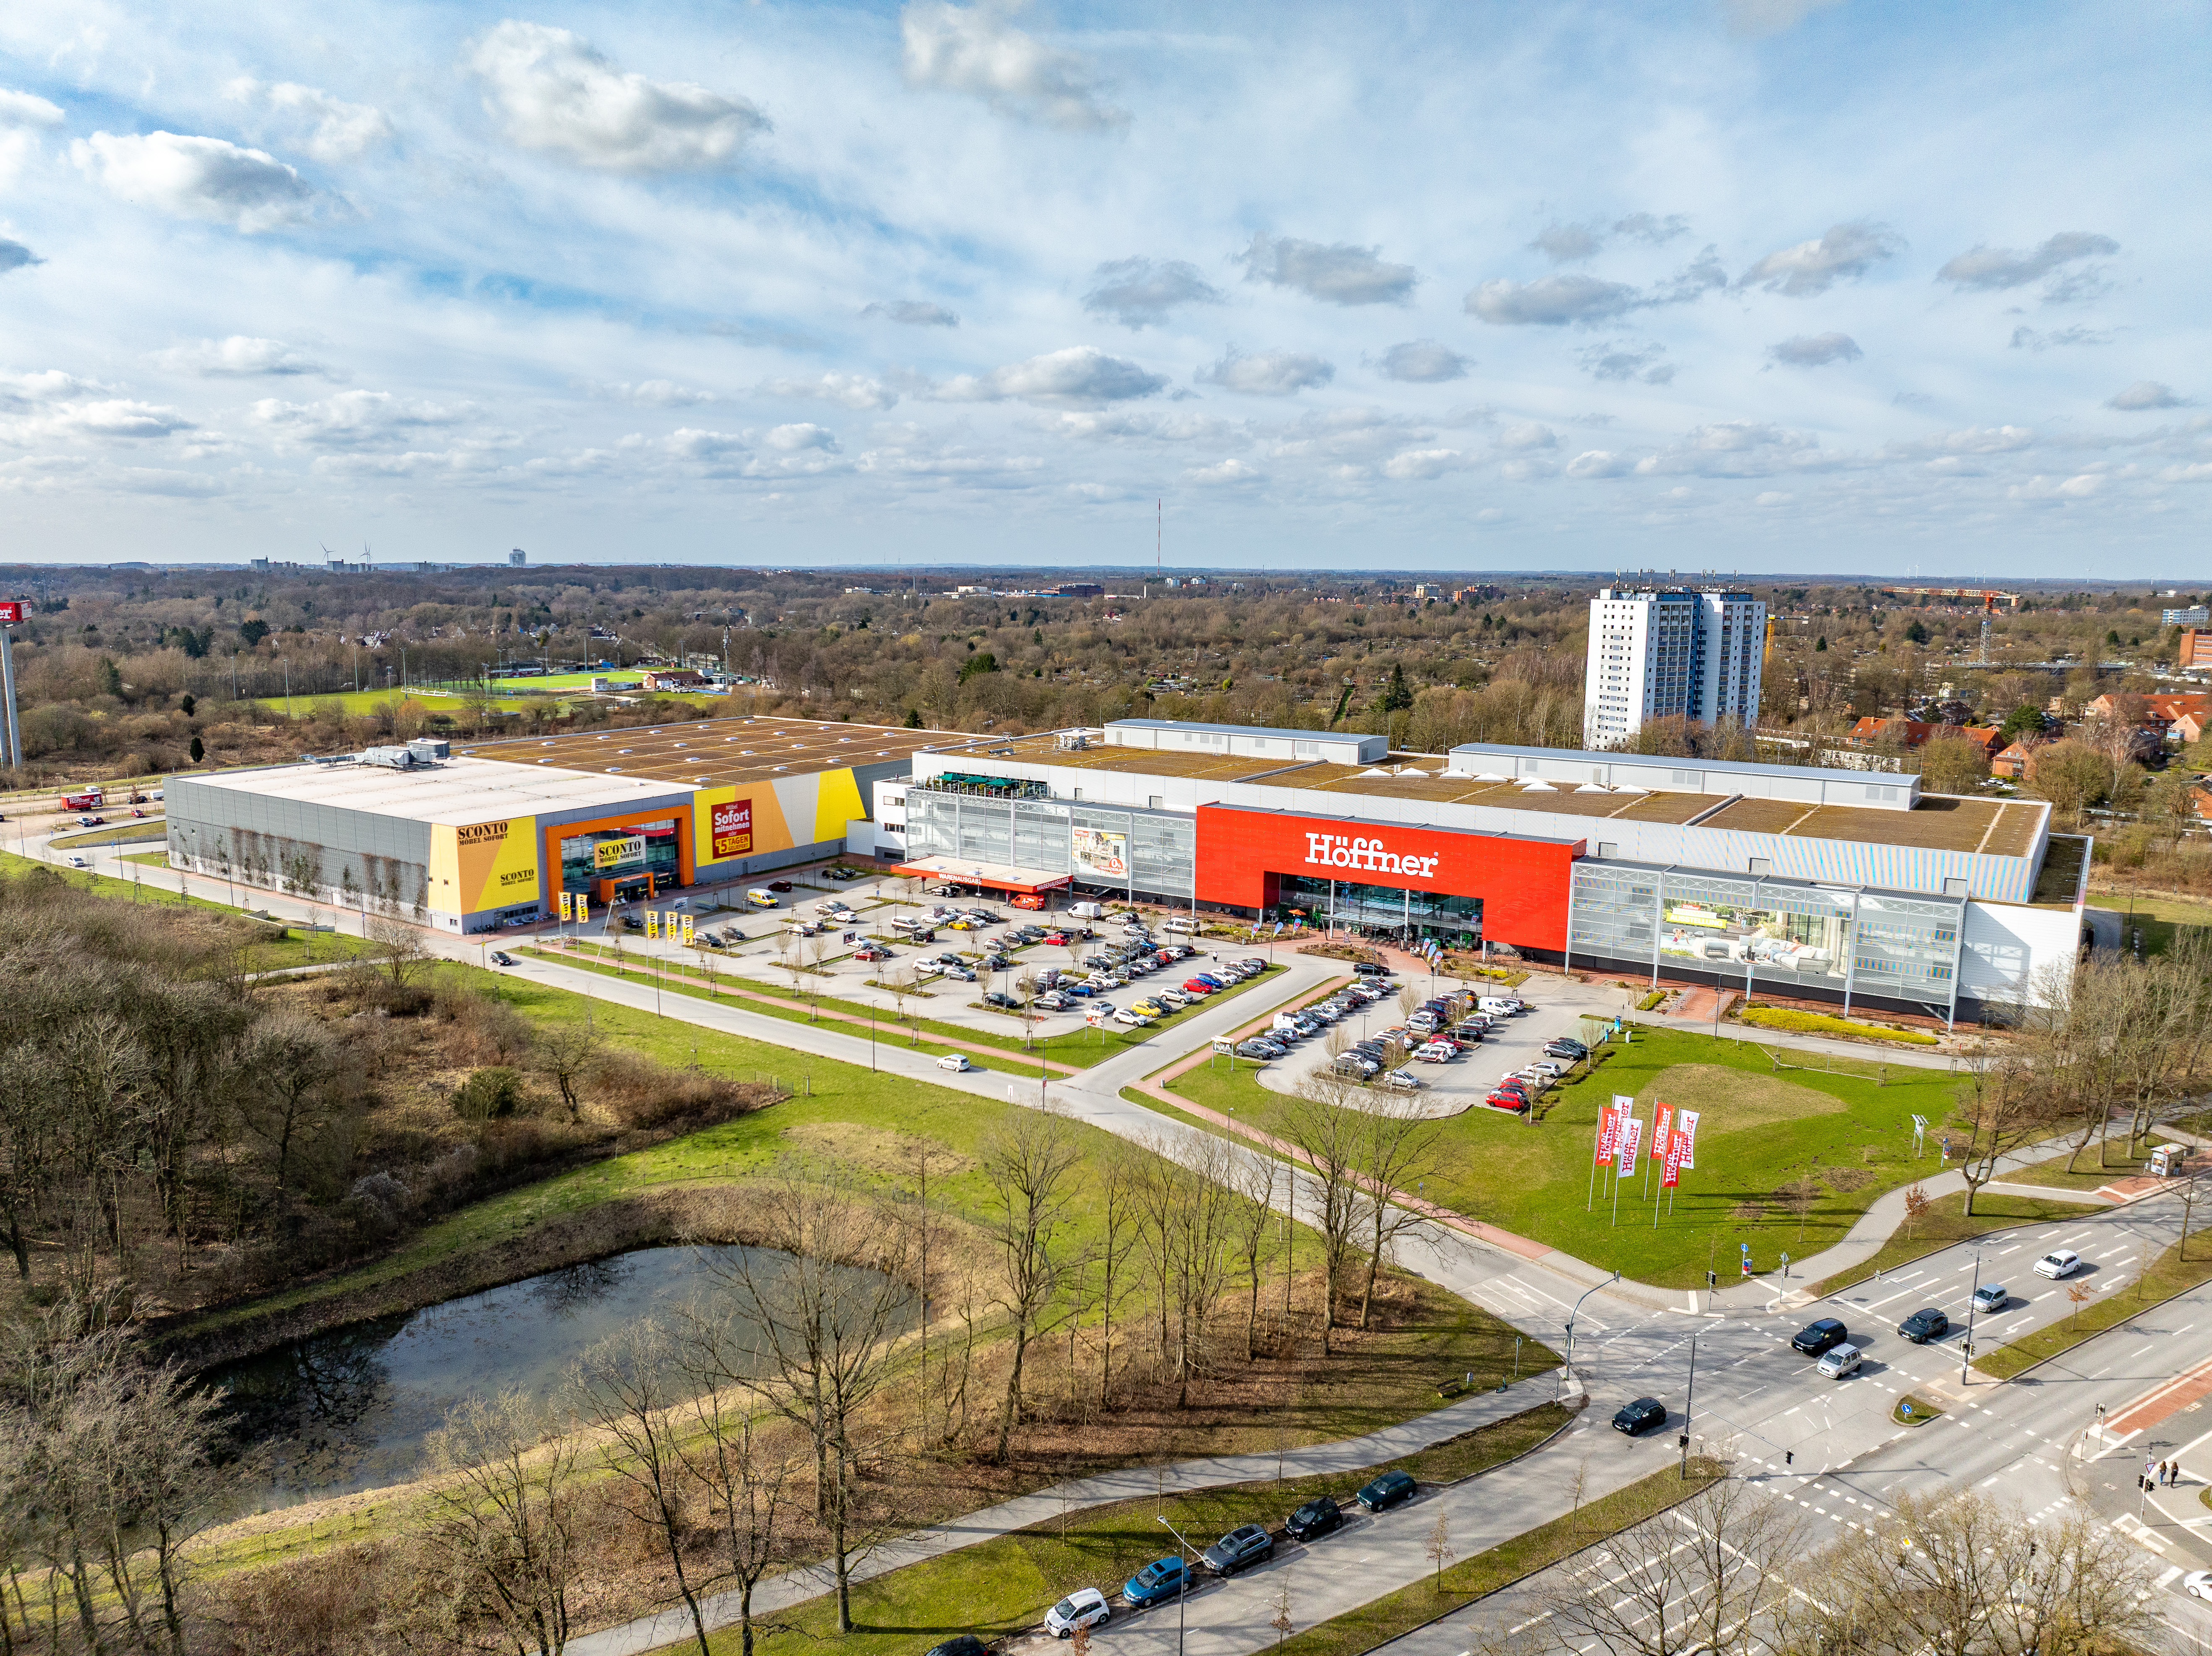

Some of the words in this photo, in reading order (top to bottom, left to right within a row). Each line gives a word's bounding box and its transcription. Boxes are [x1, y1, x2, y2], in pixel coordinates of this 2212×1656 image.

[715, 809, 749, 825] Sofort
[458, 822, 508, 839] SCONTO
[715, 822, 750, 833] mitnehmen
[459, 837, 482, 846] MÖBEL
[483, 833, 508, 842] SOFORT
[721, 839, 727, 852] 5
[728, 835, 748, 846] TAGEN
[599, 841, 641, 858] SCONTO
[599, 854, 619, 864] MÖBEL
[620, 851, 642, 860] SOFORT
[1304, 832, 1439, 877] Höffner
[1111, 859, 1122, 868] 0%
[500, 869, 534, 883] SCONTO
[938, 873, 982, 885] WARENAUSGABE
[1036, 877, 1069, 891] WARENAUSGABE
[1670, 914, 1723, 926] AUSSTELLUNG
[1599, 1113, 1616, 1161] Höffner
[1654, 1107, 1671, 1155] Höffner
[1622, 1125, 1638, 1172] Höffner
[1665, 1134, 1682, 1183] Höffner
